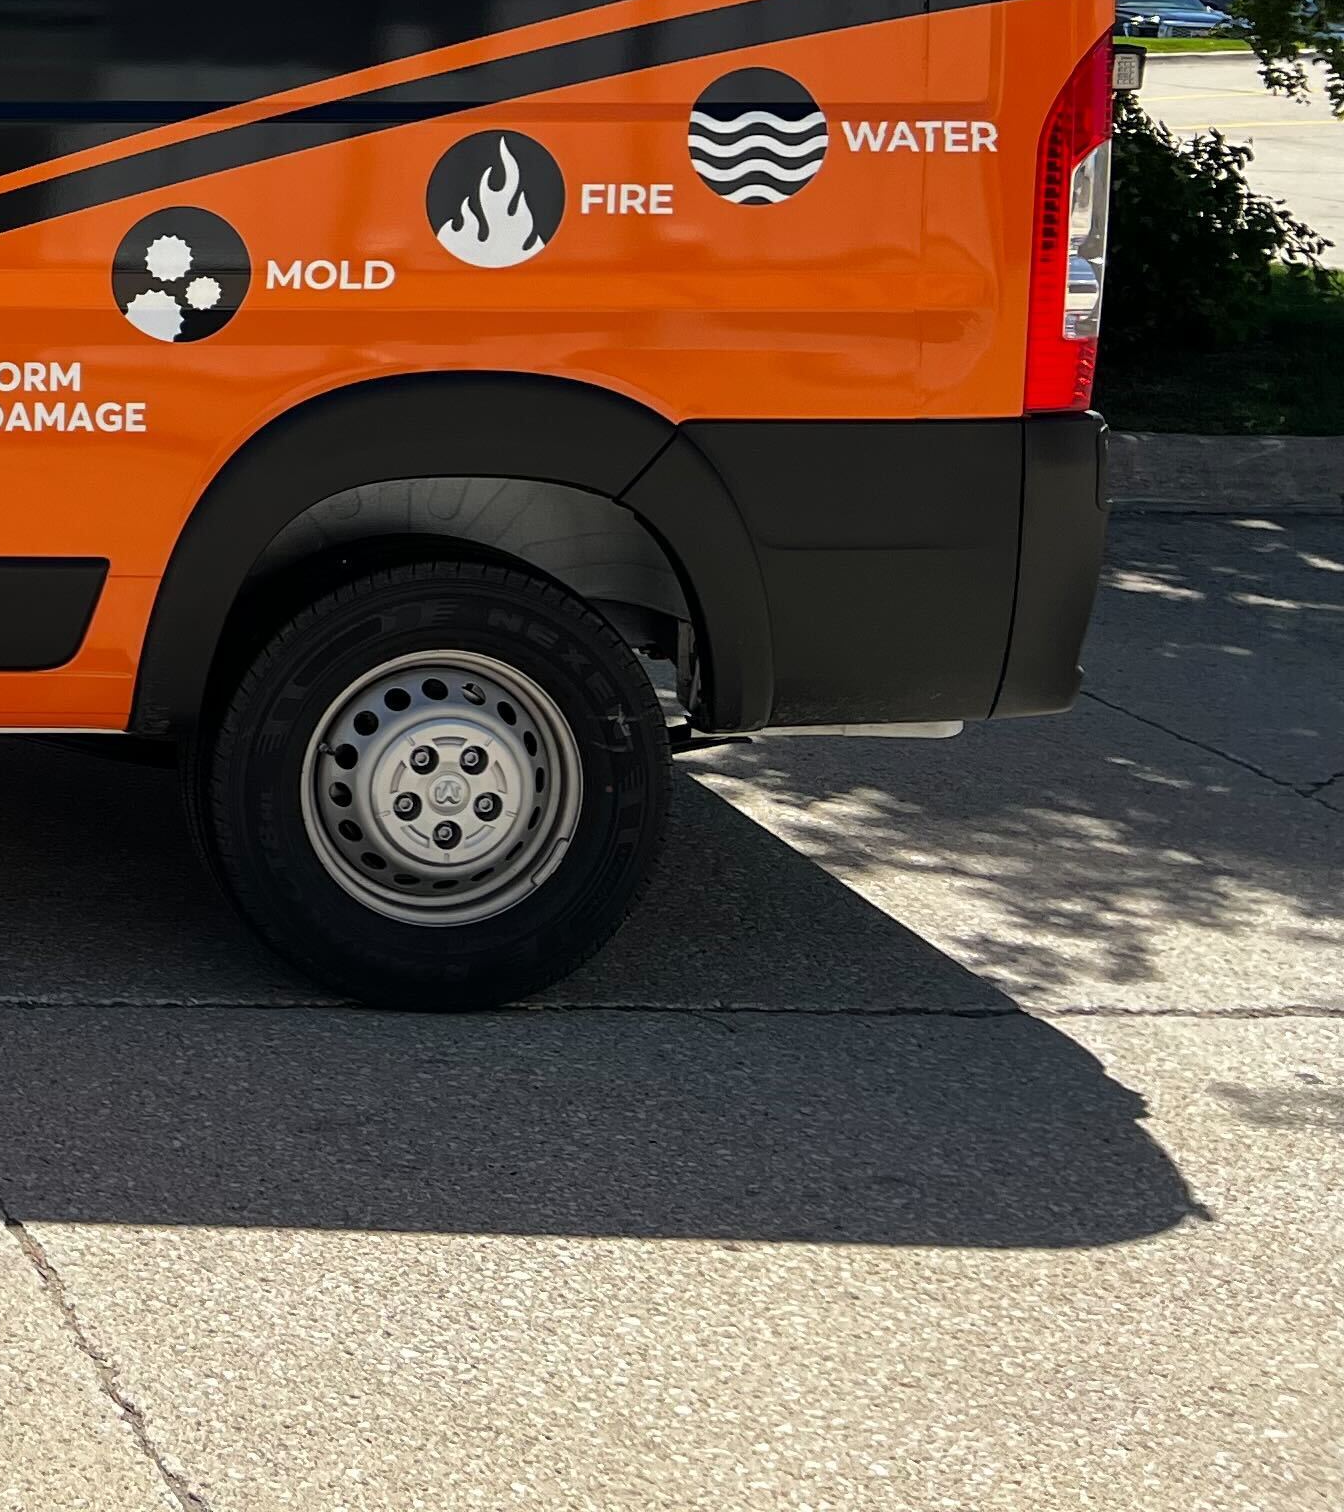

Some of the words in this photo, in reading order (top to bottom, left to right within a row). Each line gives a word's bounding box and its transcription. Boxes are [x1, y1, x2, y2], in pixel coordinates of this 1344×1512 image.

[842, 120, 998, 153] WATER
[581, 183, 674, 215] FIRE
[267, 260, 395, 290] MOLD
